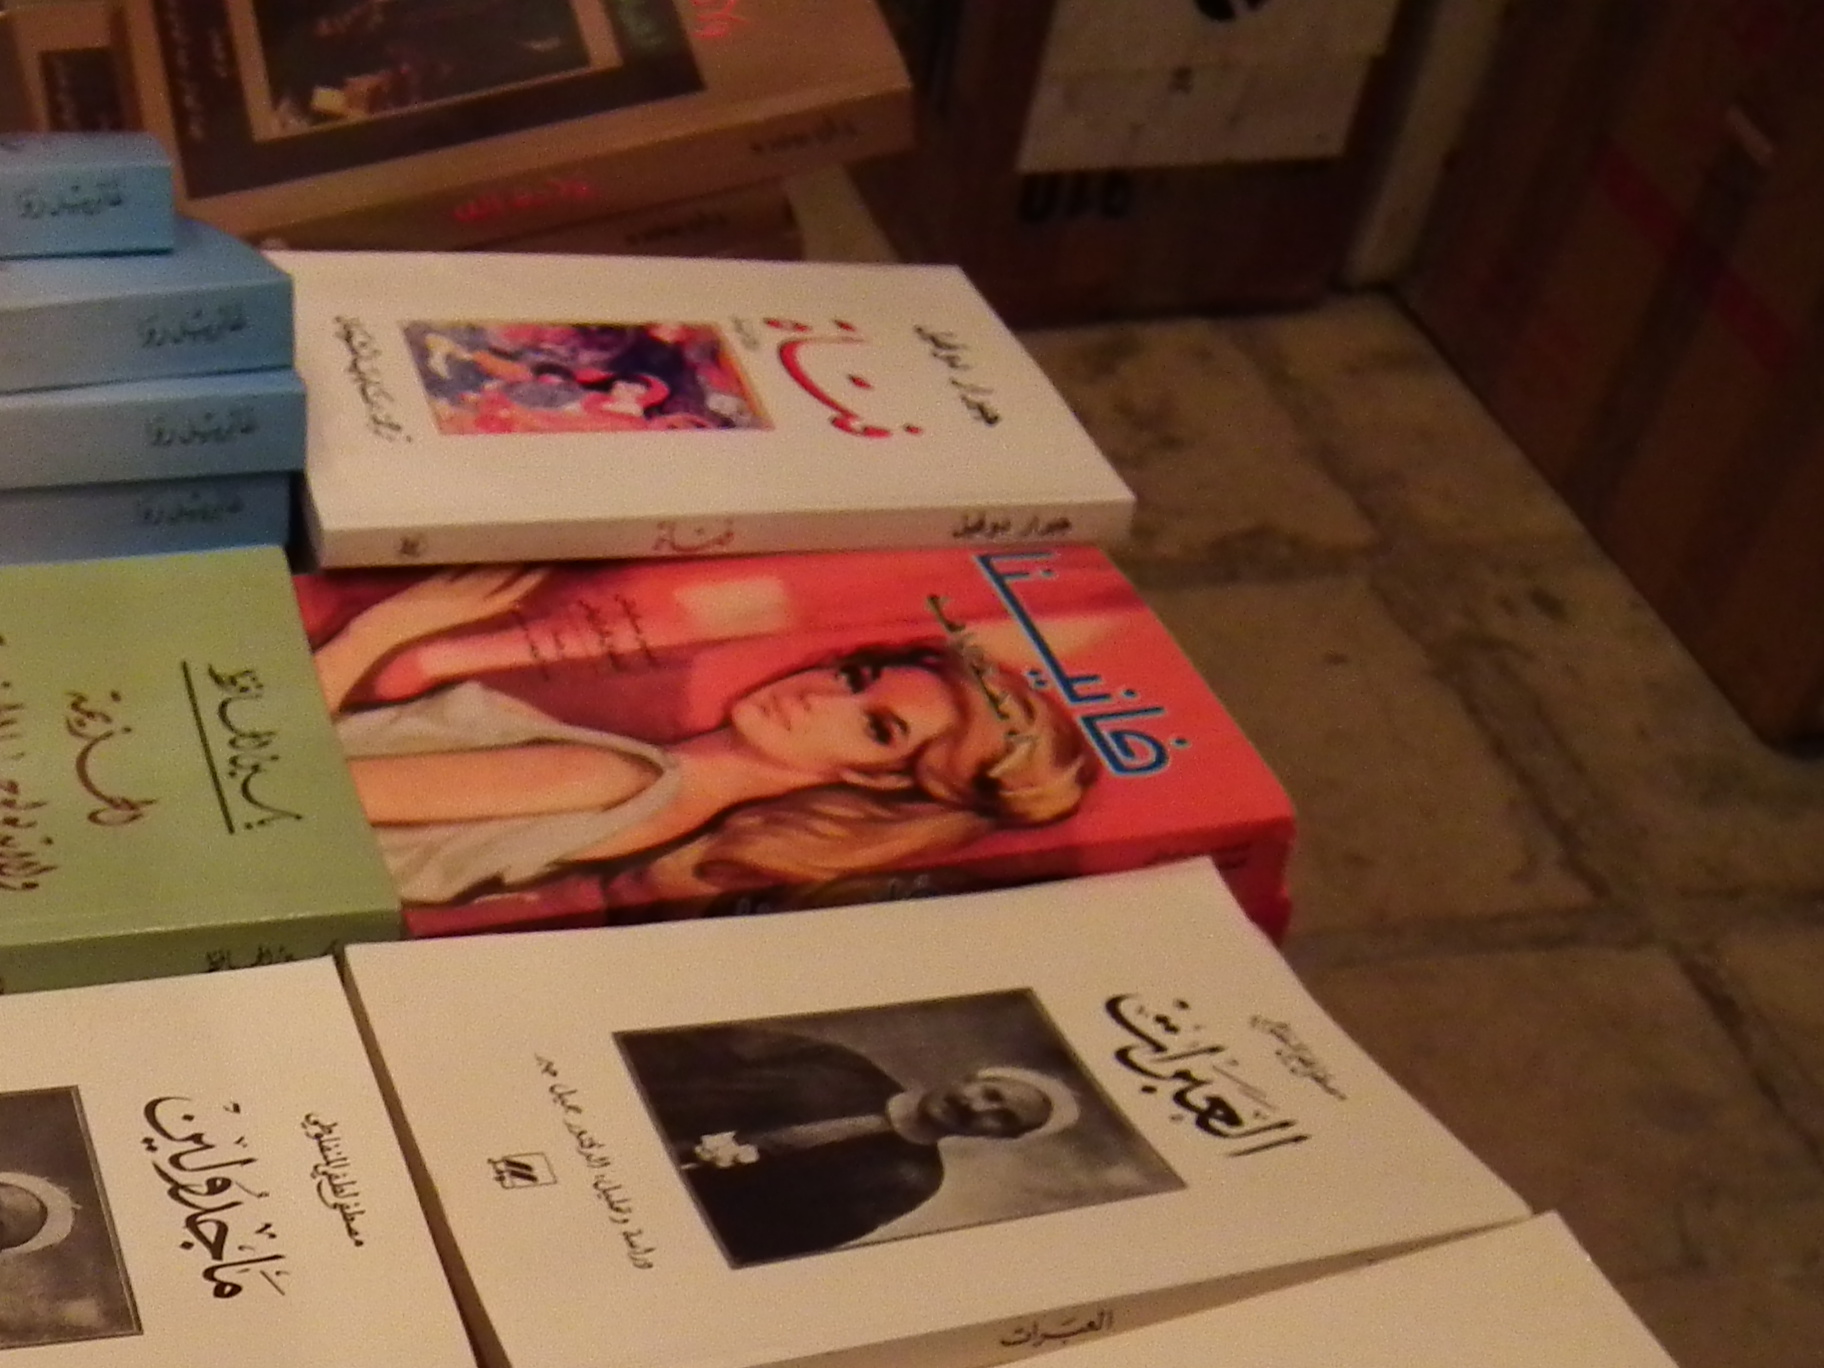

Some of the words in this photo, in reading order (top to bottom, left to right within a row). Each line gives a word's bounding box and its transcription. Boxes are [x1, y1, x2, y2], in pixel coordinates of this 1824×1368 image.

[65, 692, 161, 827] الهزيمة
[1105, 994, 1313, 1159] العبرات
[301, 1111, 349, 1169] المنفلوطي
[143, 1095, 292, 1301] ماجدولين
[309, 1164, 361, 1201] لطفي
[316, 1178, 368, 1249] مصطفى
[622, 1231, 657, 1270] دراسة
[1000, 1308, 1114, 1348] العبرات
